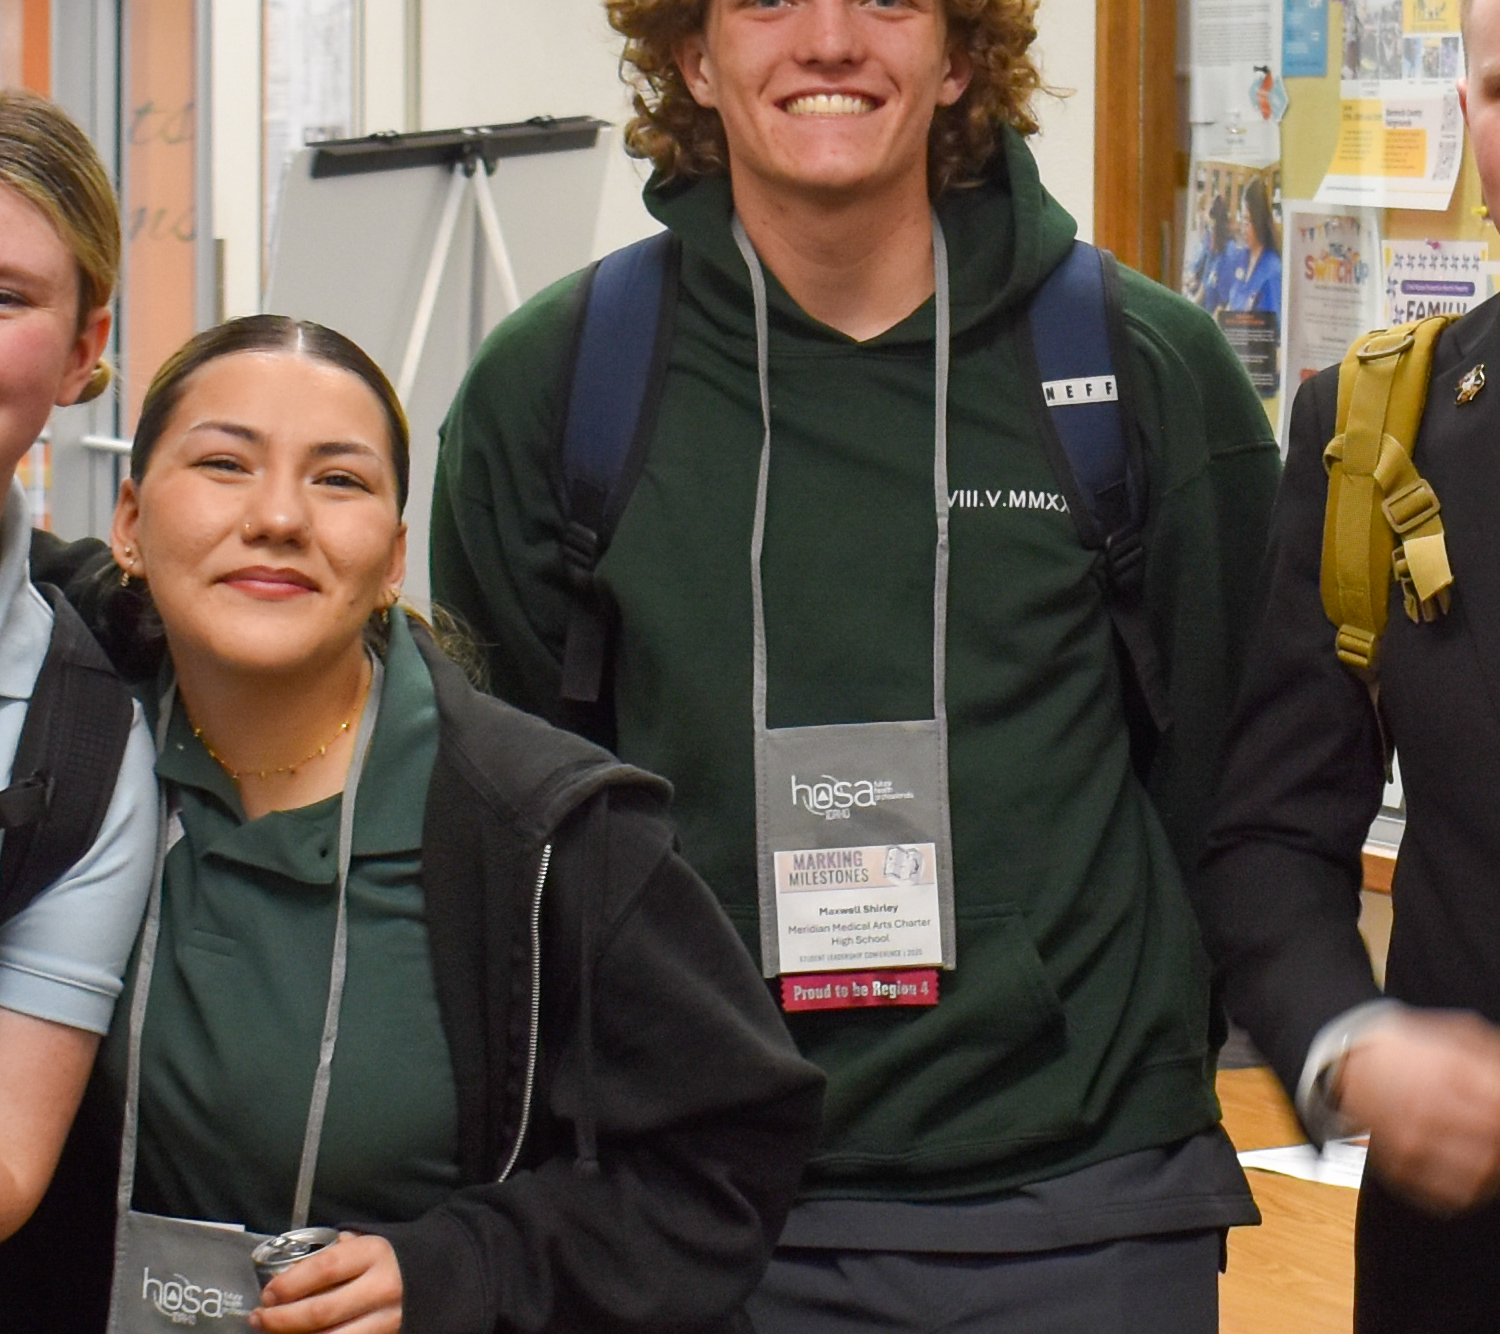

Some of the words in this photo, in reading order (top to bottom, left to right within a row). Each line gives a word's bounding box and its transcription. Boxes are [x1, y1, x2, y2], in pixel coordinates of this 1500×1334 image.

[1045, 381, 1114, 402] NEFF
[791, 774, 877, 810] hosa
[793, 850, 863, 871] MARKING
[789, 868, 869, 886] MILESTONES
[819, 906, 860, 916] Maxwell
[863, 903, 899, 915] Shirley
[788, 923, 831, 935] Meridian
[832, 921, 871, 932] Medical
[894, 918, 931, 929] Charter
[793, 984, 832, 1001] Proud
[872, 980, 917, 999] Region
[142, 1267, 223, 1318] hosa
